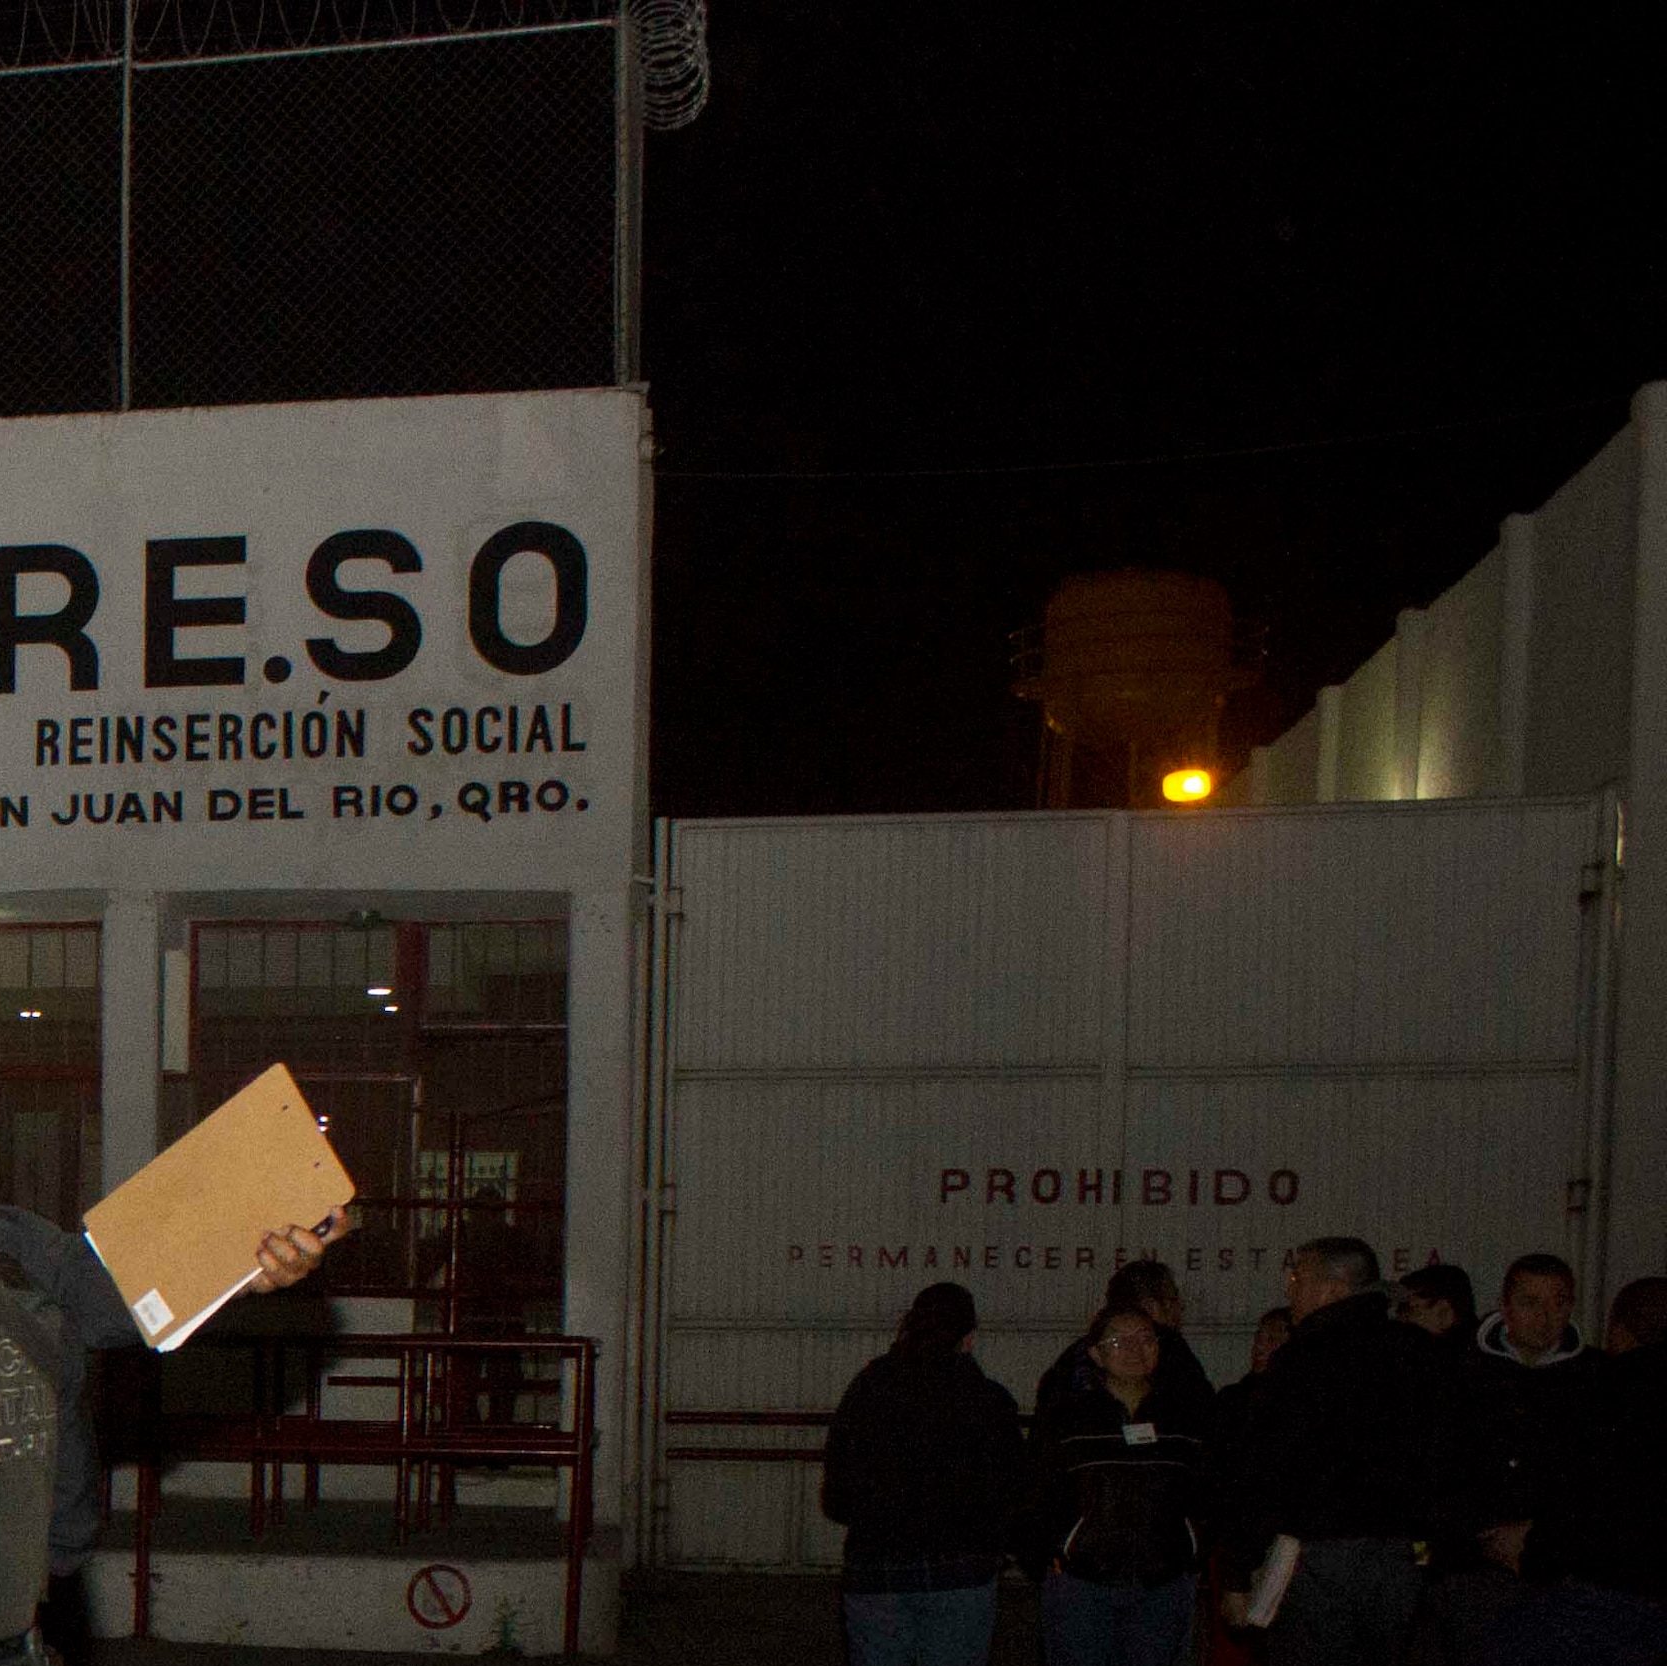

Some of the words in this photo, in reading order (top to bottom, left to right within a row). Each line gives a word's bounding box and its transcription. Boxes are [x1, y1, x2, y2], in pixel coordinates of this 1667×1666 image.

[35, 690, 367, 767] REINSERCIÓN
[406, 702, 588, 757] SOCIAL
[50, 790, 184, 827] JUAN
[208, 787, 306, 823] DEL
[457, 778, 591, 824] QRO.
[939, 1167, 1300, 1207] PROHIBIDO
[787, 1244, 1096, 1271] PERMANECER
